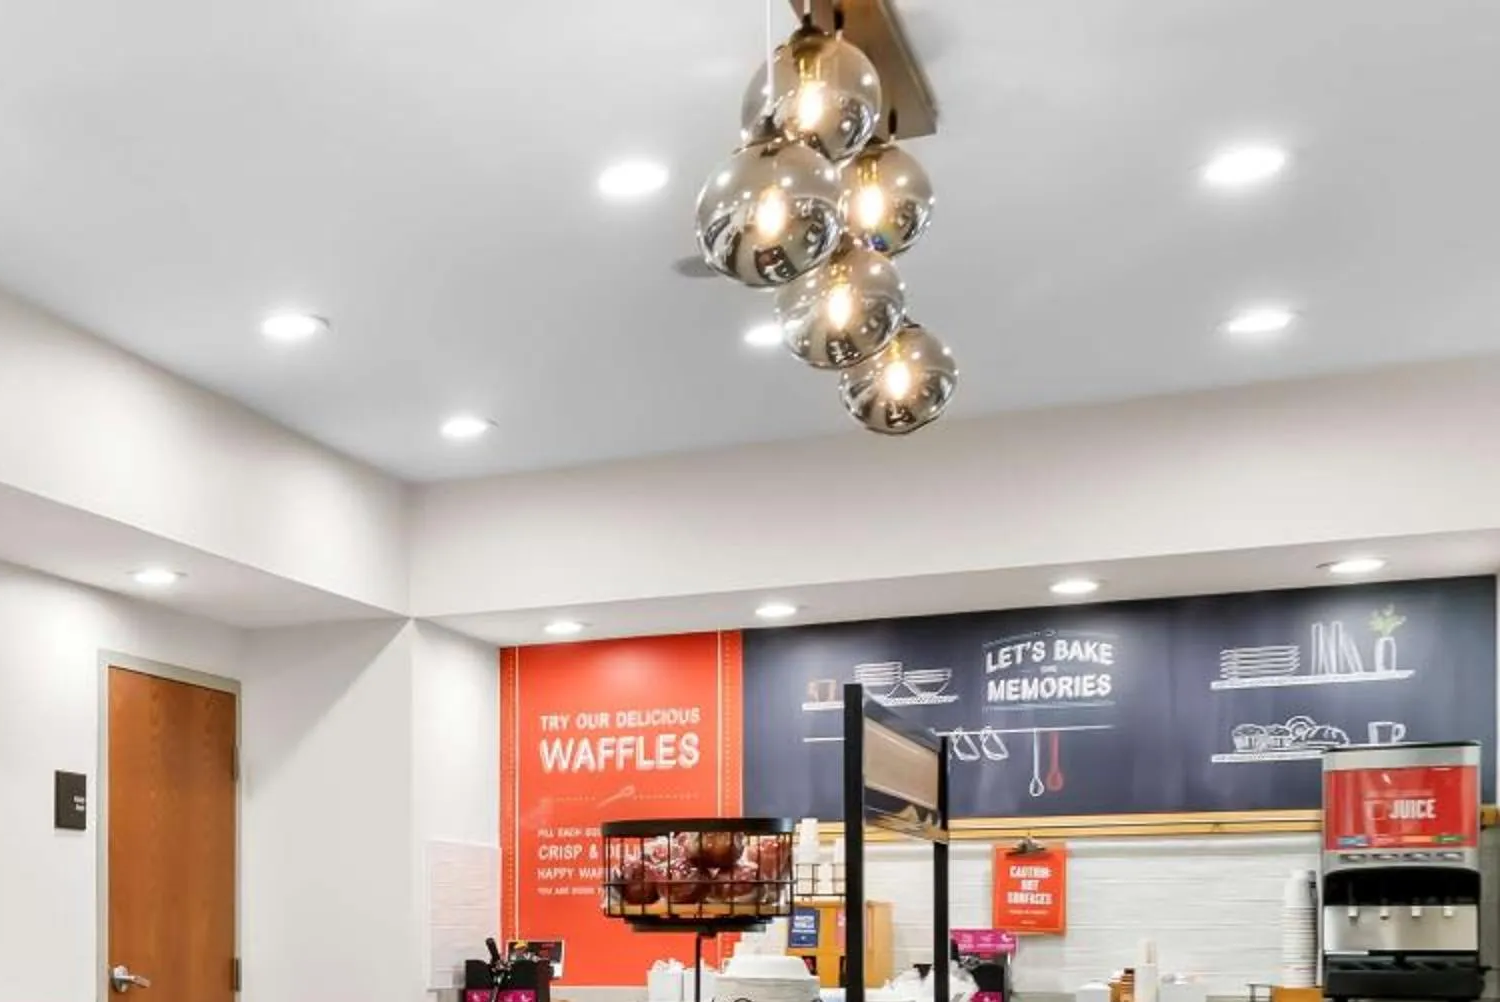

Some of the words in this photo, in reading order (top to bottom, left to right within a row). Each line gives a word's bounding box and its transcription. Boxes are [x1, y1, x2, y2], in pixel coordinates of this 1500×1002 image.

[985, 640, 1046, 674] LET'S
[1052, 639, 1115, 665] BAKE
[987, 674, 1113, 702] MEMORIES
[540, 714, 569, 731] TRY
[576, 712, 610, 729] OUR
[615, 707, 701, 728] DELICIOUS
[539, 732, 700, 773] WAFFLES
[1389, 799, 1437, 819] JUICE
[539, 844, 583, 860] CRISP
